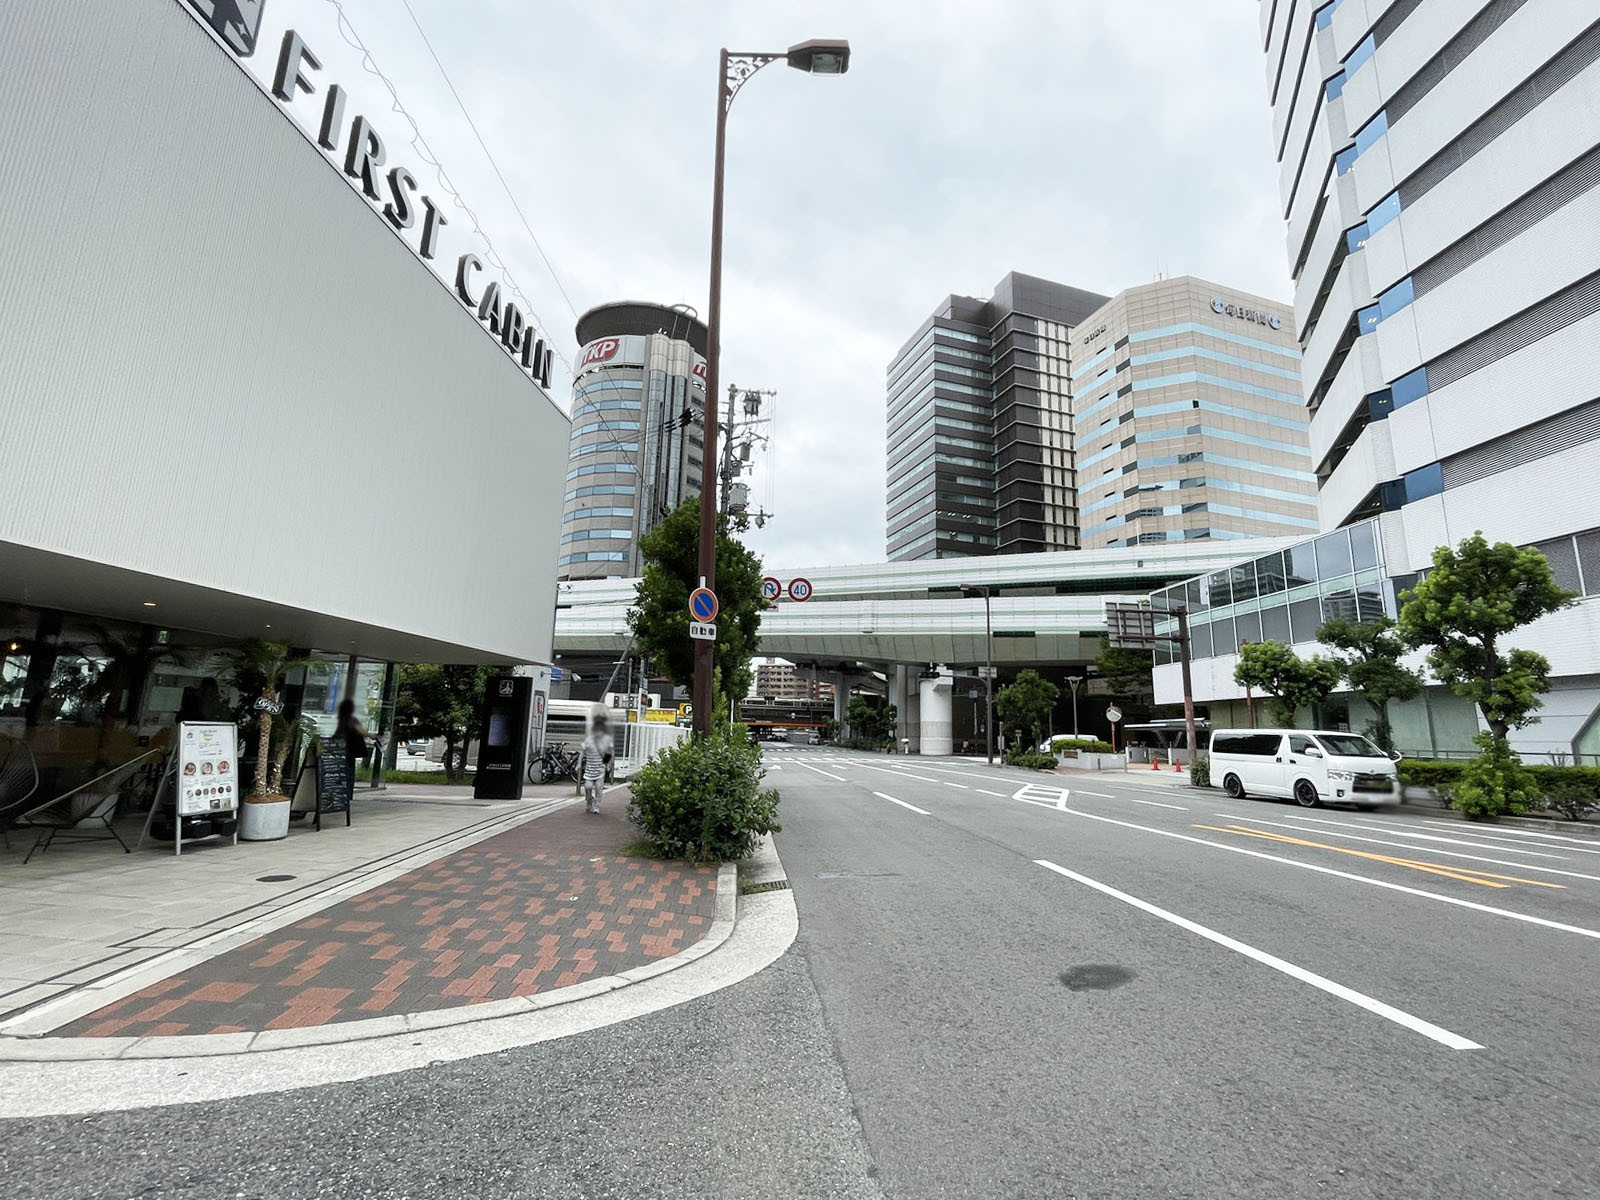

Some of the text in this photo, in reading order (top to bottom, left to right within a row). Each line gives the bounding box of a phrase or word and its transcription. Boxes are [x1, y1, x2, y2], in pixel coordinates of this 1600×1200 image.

[272, 29, 555, 390] FIRST CABIN
[793, 584, 807, 596] 40
